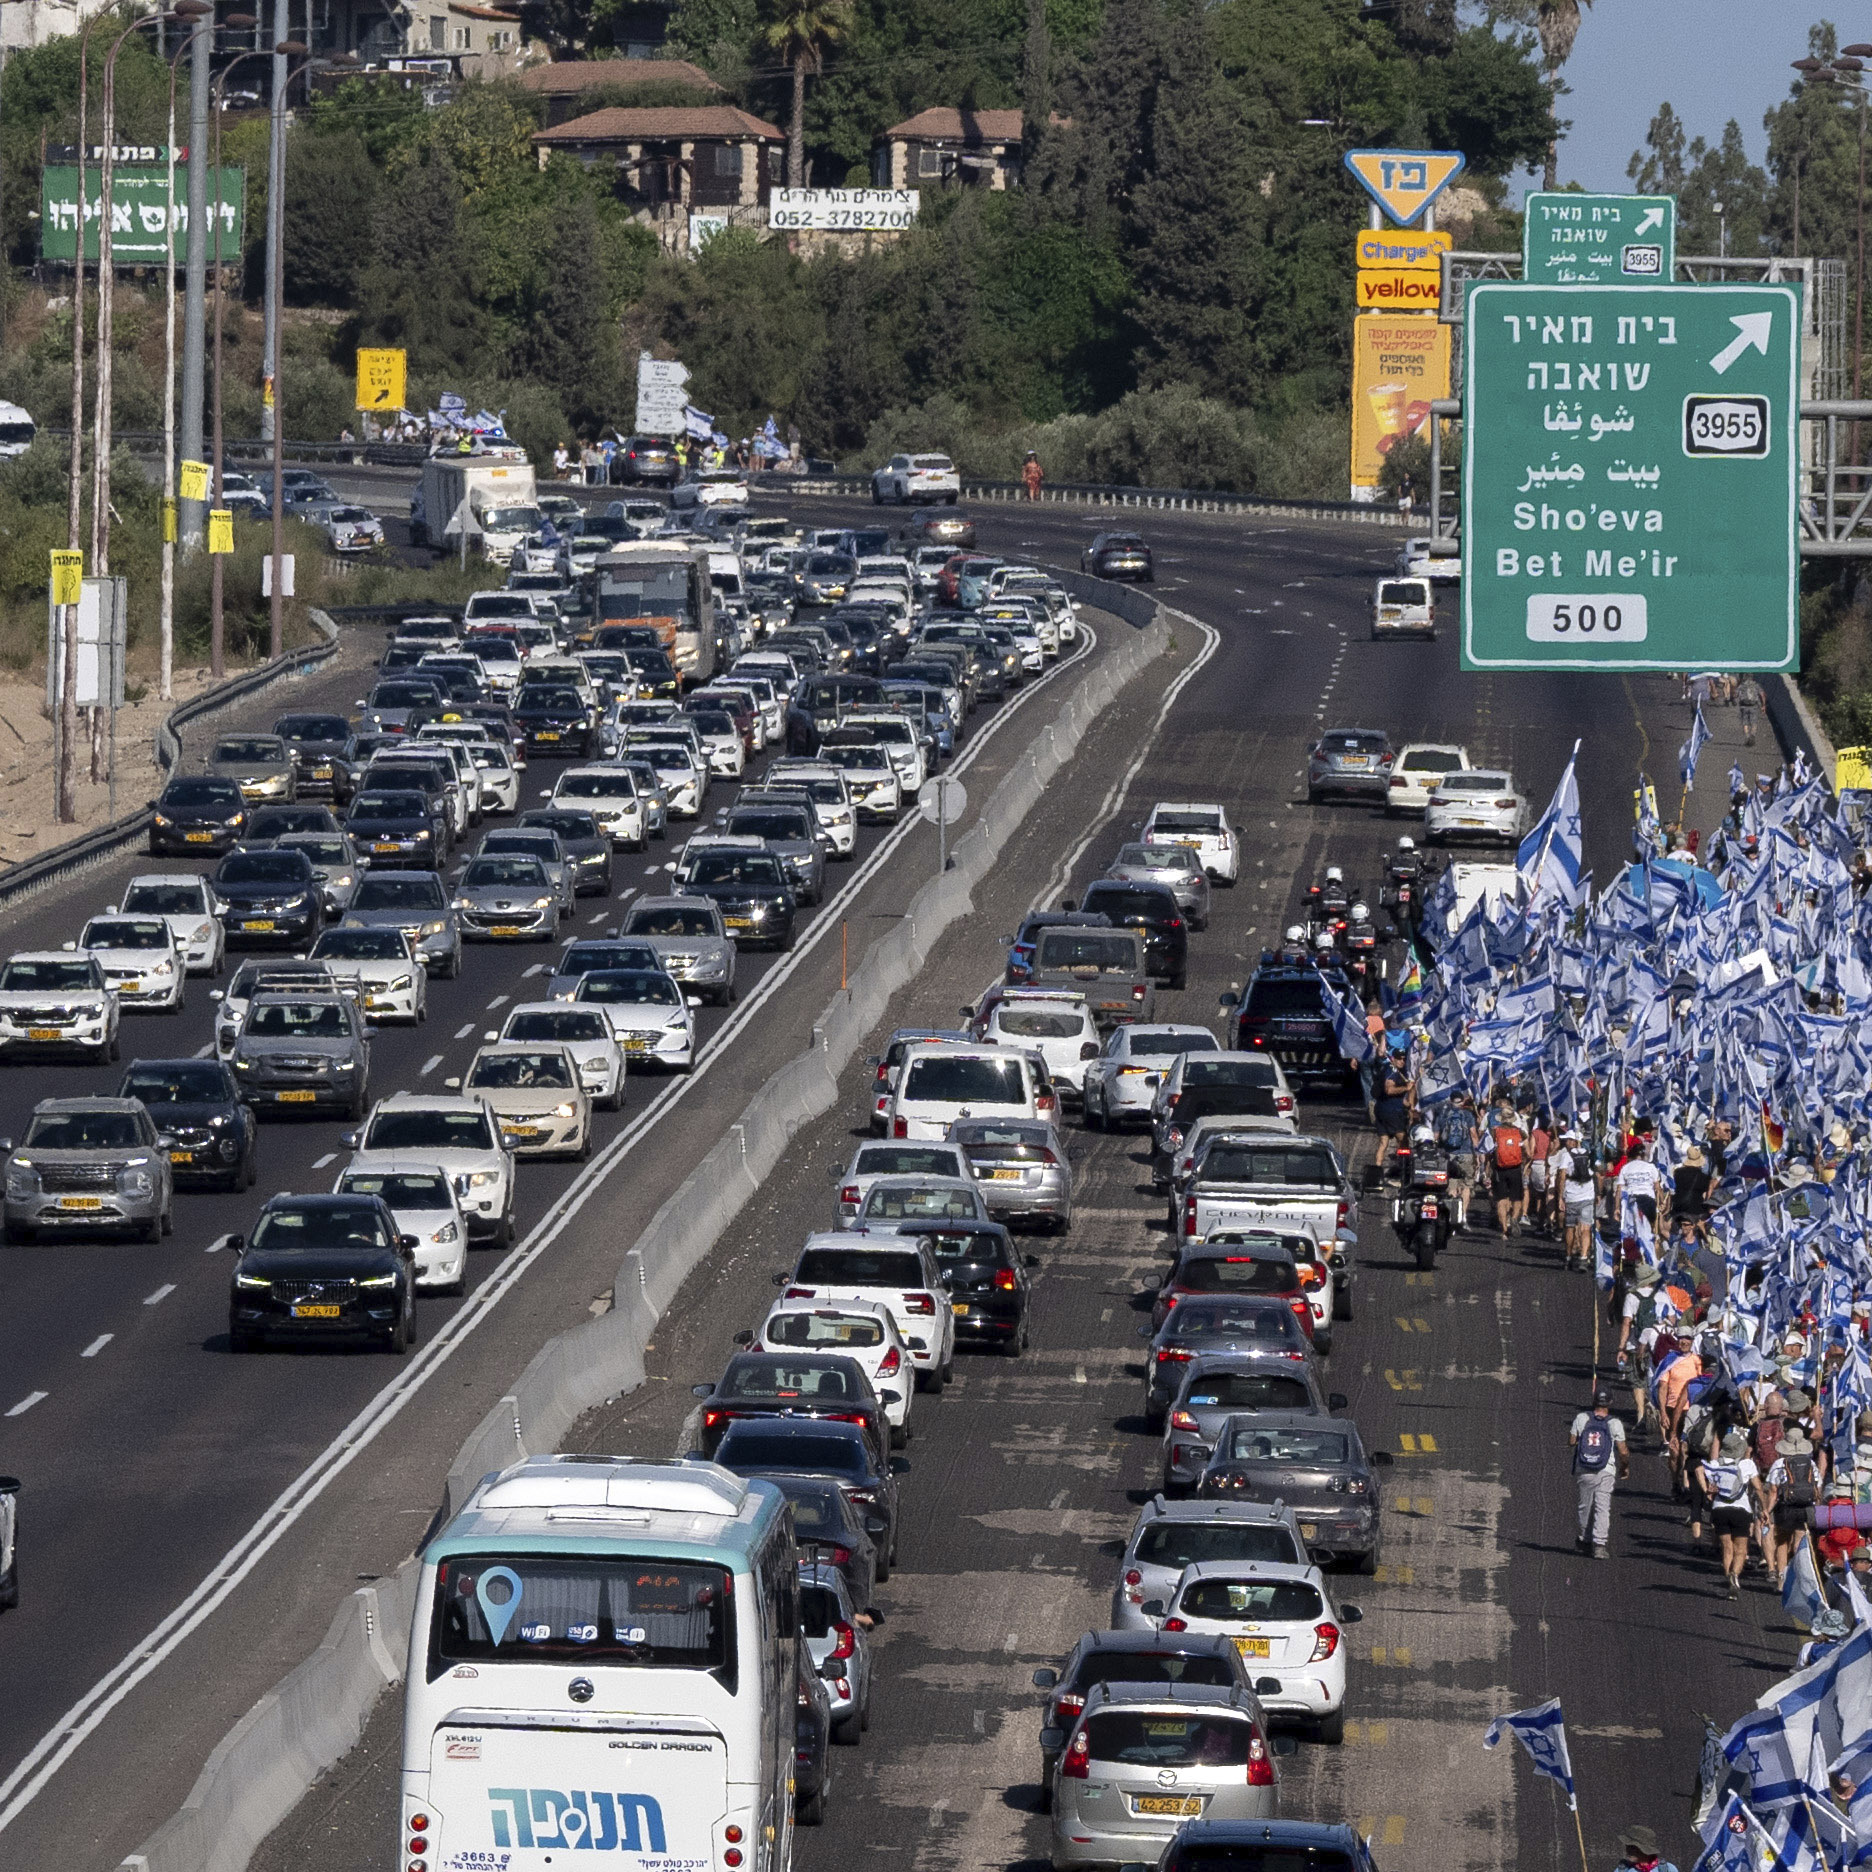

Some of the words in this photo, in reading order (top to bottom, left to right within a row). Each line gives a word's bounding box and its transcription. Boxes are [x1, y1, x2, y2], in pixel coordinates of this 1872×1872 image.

[1380, 161, 1427, 190] פז
[776, 211, 913, 226] 052-3782700
[1541, 205, 1582, 222] מאיר
[1592, 207, 1621, 222] בית
[1552, 228, 1608, 243] שואבה
[1363, 242, 1428, 273] Charge
[1629, 254, 1656, 267] 3955
[1364, 278, 1440, 299] yellow
[1503, 314, 1594, 344] מאיר
[1618, 316, 1678, 344] בית
[1528, 361, 1651, 392] שואבה
[1696, 411, 1756, 439] 3955
[1606, 459, 1661, 490] بيت
[1513, 501, 1664, 532] Sho'eva
[1496, 547, 1563, 577] Bet
[1584, 547, 1679, 578] Me'ir
[1553, 604, 1623, 633] 500
[608, 1740, 657, 1751] GOLDEN
[660, 1742, 713, 1752] DRAGON
[487, 1787, 667, 1853] תנופה
